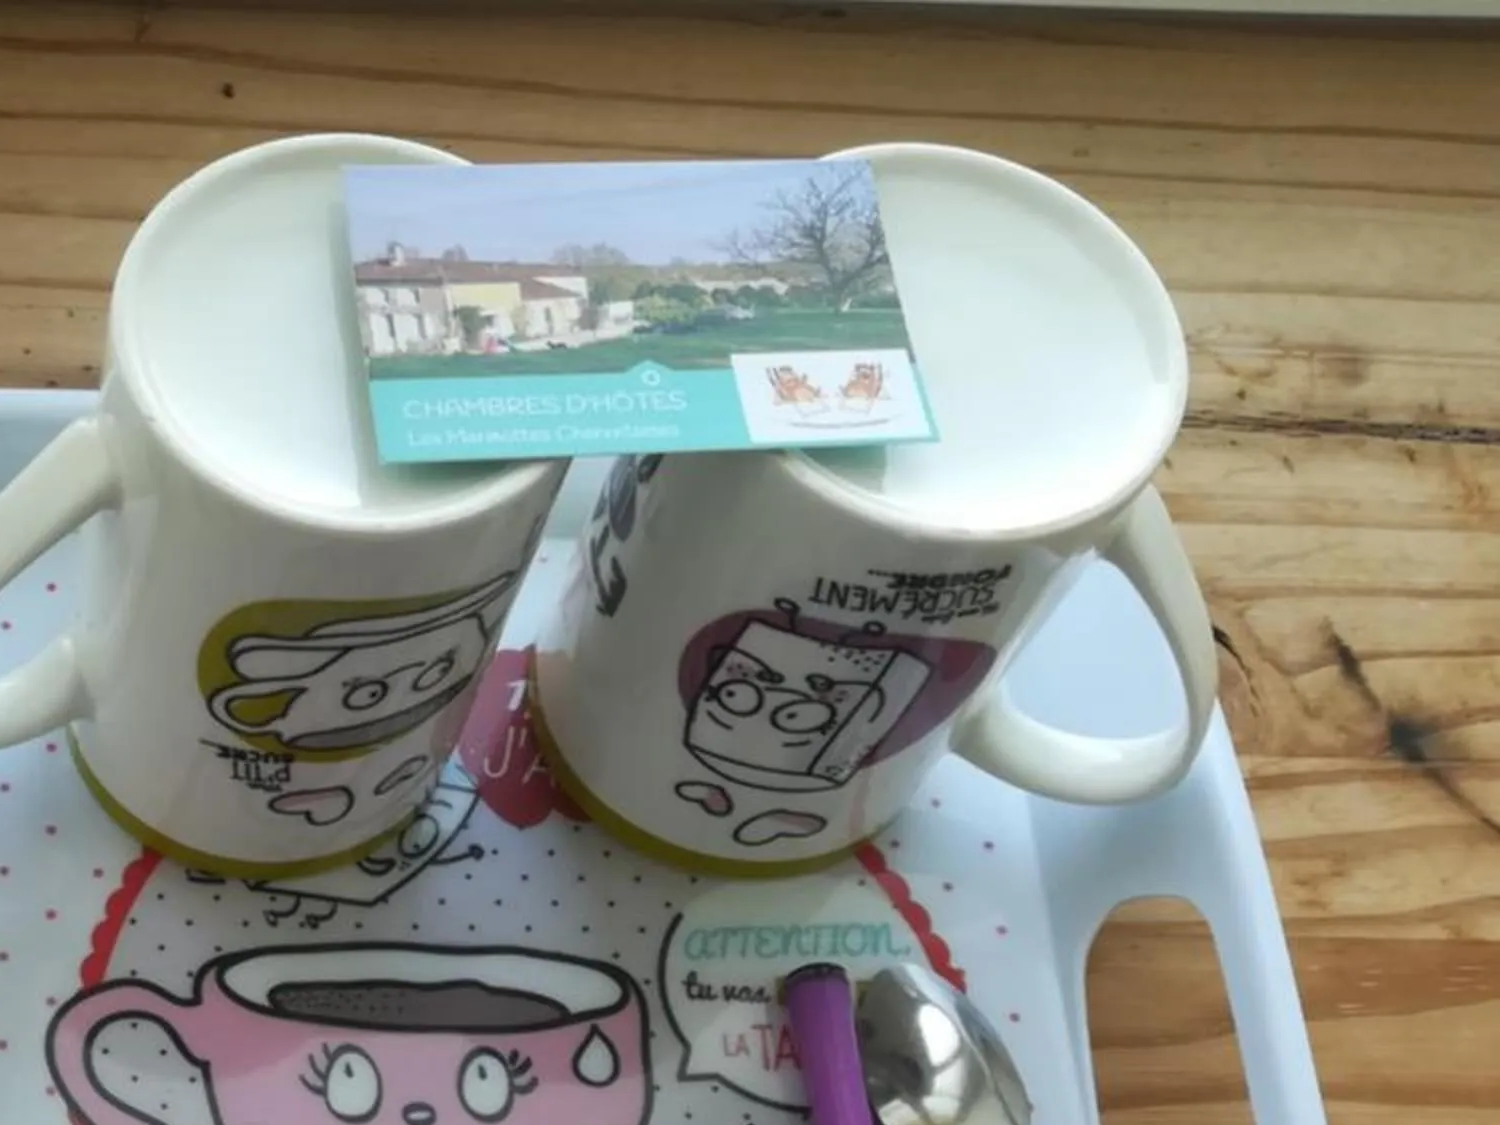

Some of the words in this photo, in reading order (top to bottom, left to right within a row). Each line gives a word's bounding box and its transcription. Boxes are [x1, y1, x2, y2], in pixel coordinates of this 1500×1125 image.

[403, 394, 562, 420] CHAMBRES
[566, 389, 690, 414] D'HÔTES
[682, 970, 719, 1002] tu
[722, 1032, 750, 1057] LA
